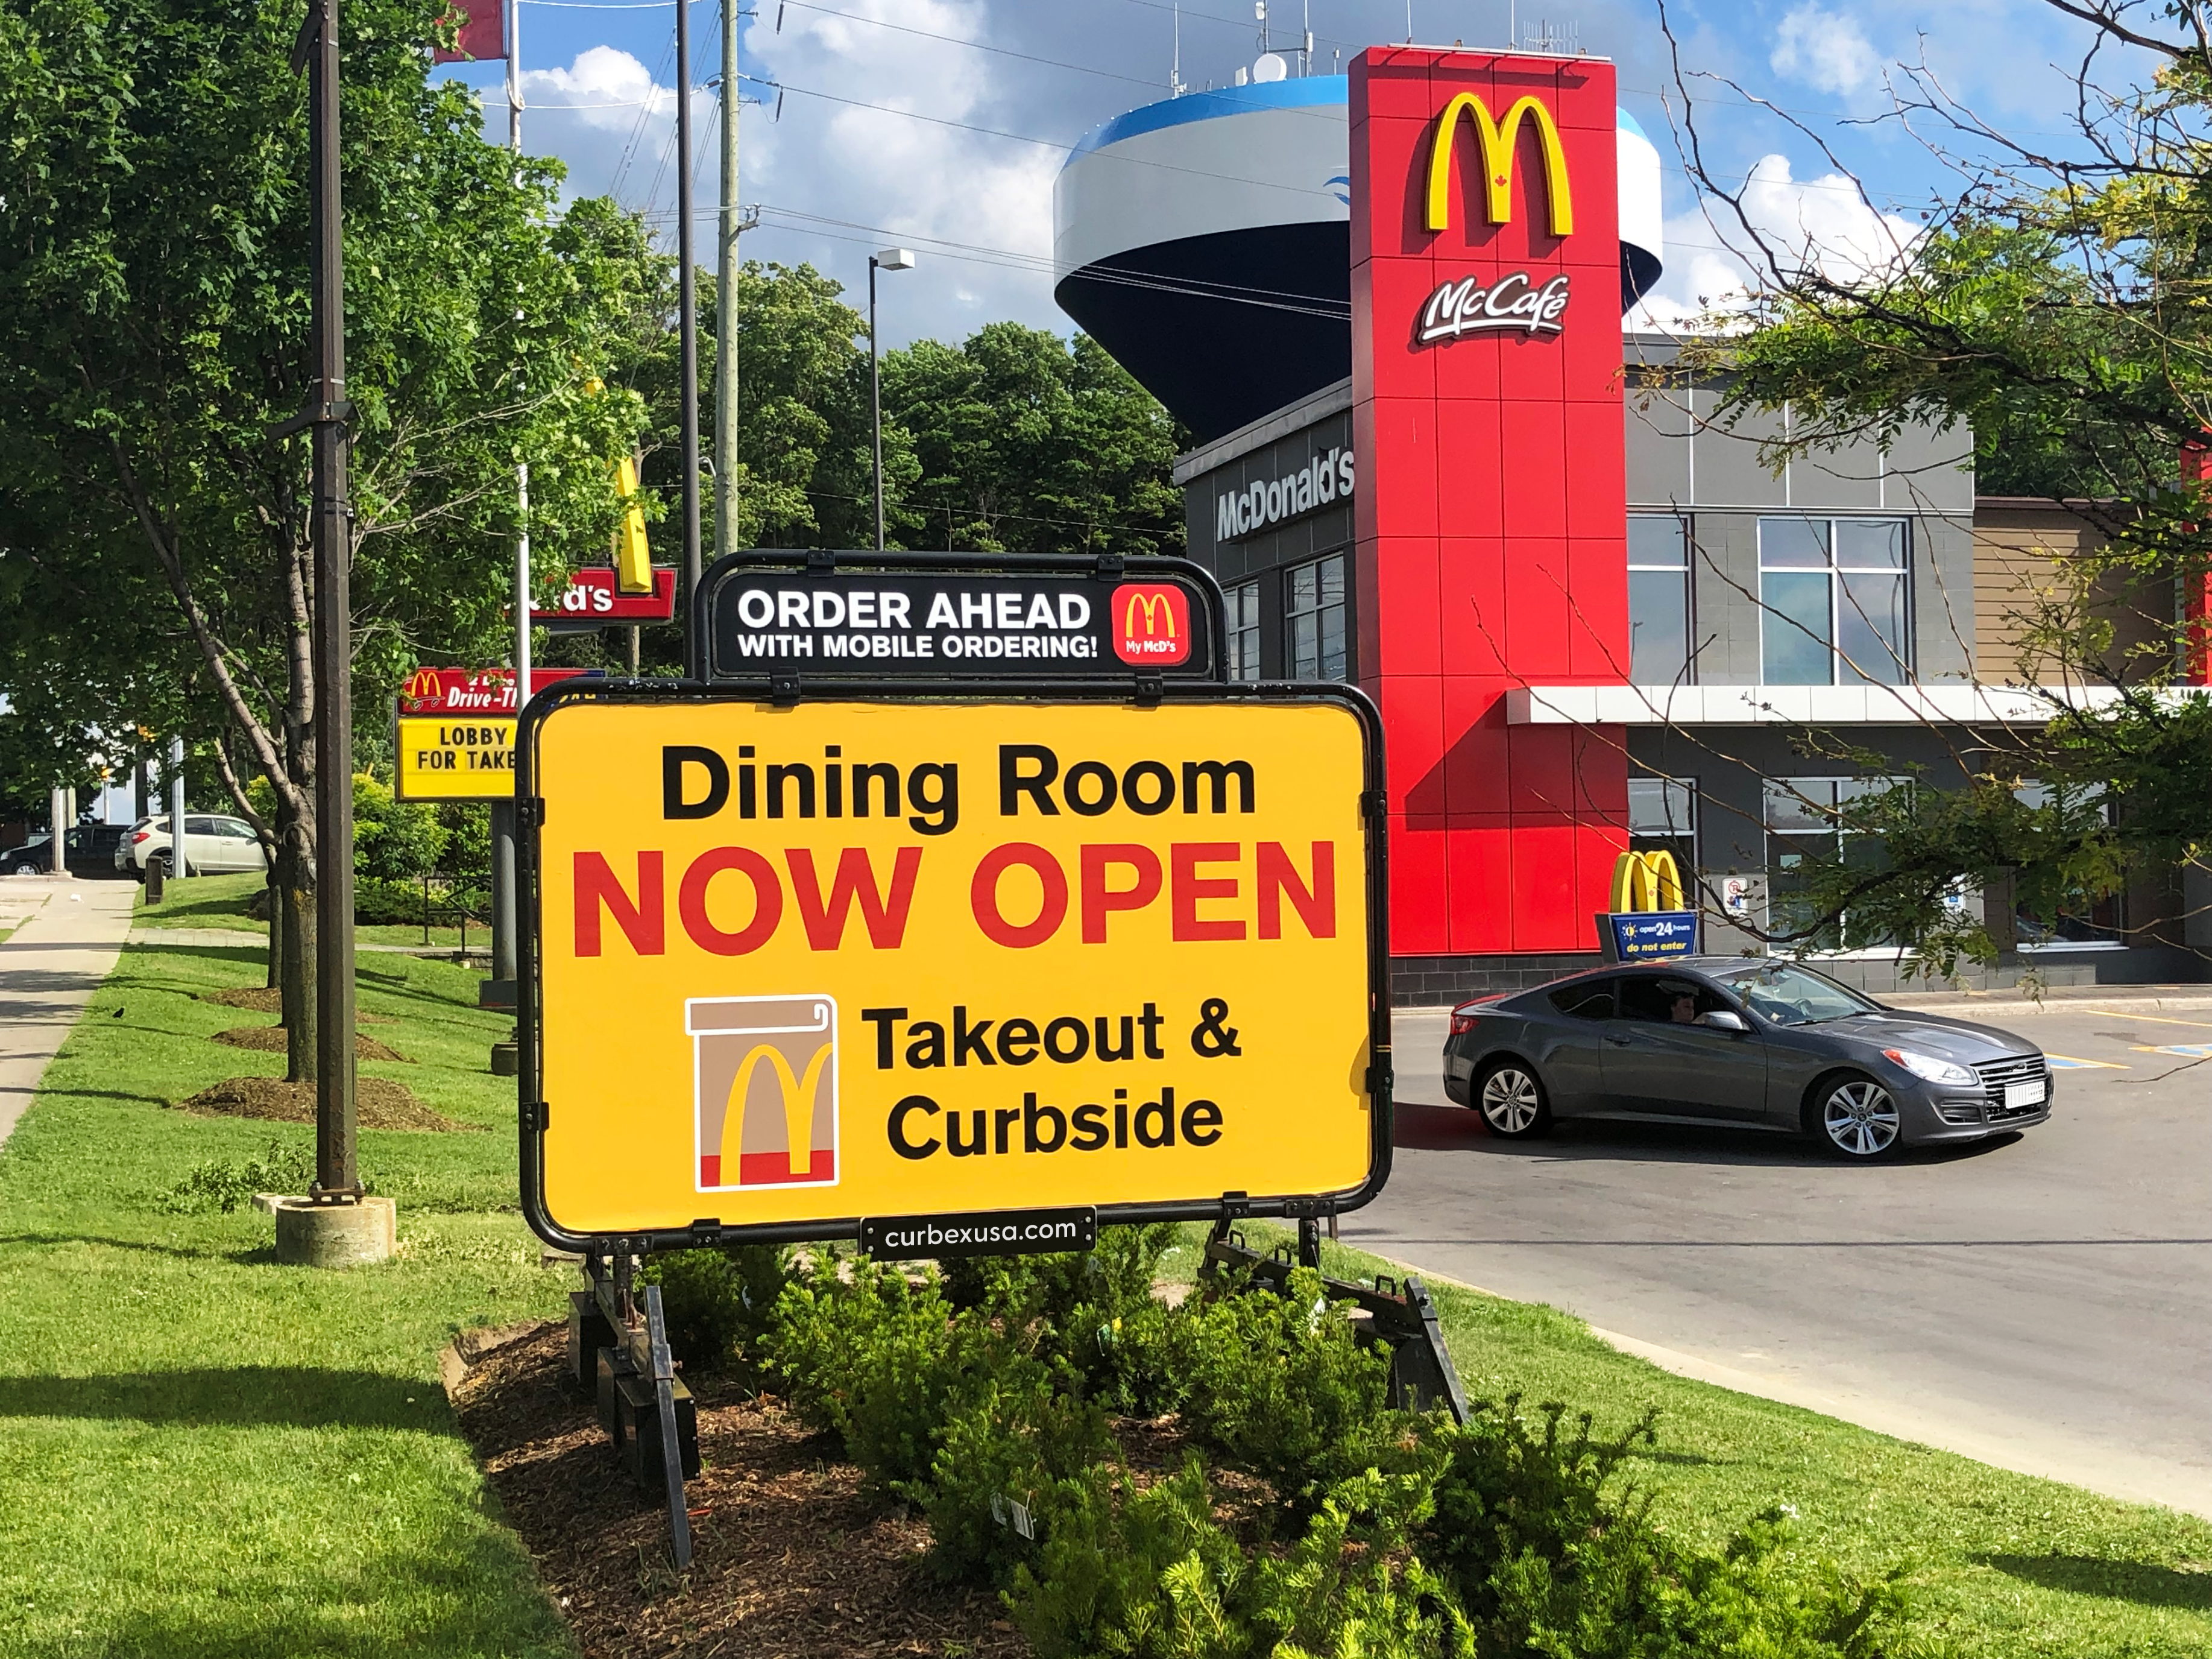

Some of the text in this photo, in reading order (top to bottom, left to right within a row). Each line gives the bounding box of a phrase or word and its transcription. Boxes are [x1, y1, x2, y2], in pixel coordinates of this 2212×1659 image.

[1422, 274, 1568, 340] McCafé
[1217, 447, 1355, 542] McDonald's
[737, 590, 1091, 630] ORDER AHEAD
[738, 634, 1098, 659] WITH MOBILE ORDERING!
[1126, 640, 1176, 655] My McD's
[441, 727, 508, 746] LOBBY
[418, 751, 456, 770] FOR
[663, 745, 1256, 835] Dining Room
[573, 841, 1337, 959] NOW OPEN
[1656, 922, 1673, 936] 24
[1627, 941, 1687, 952] do not enter
[862, 999, 1243, 1070] Takeout &
[887, 1086, 1223, 1160] Curbside
[885, 1222, 1076, 1248] curbexusa.com
